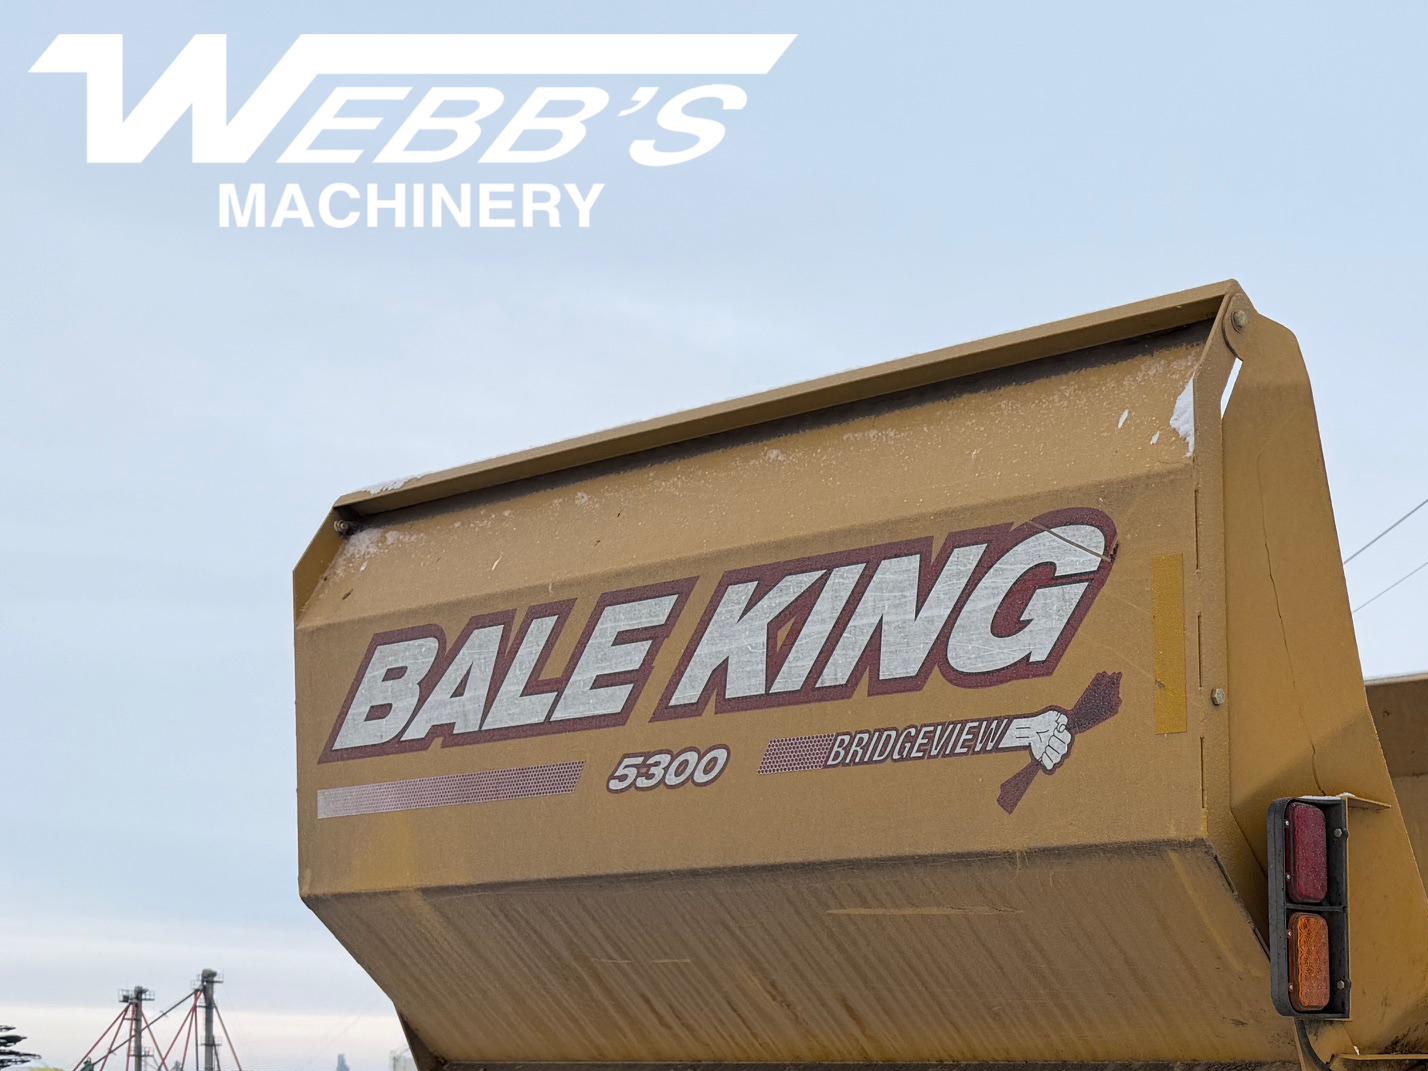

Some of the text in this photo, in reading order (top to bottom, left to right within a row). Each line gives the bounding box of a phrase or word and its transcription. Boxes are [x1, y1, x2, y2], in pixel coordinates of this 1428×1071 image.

[332, 524, 1107, 750] BALE KING
[827, 718, 1009, 767] BRIDGEVIEW
[608, 747, 728, 791] 5300
